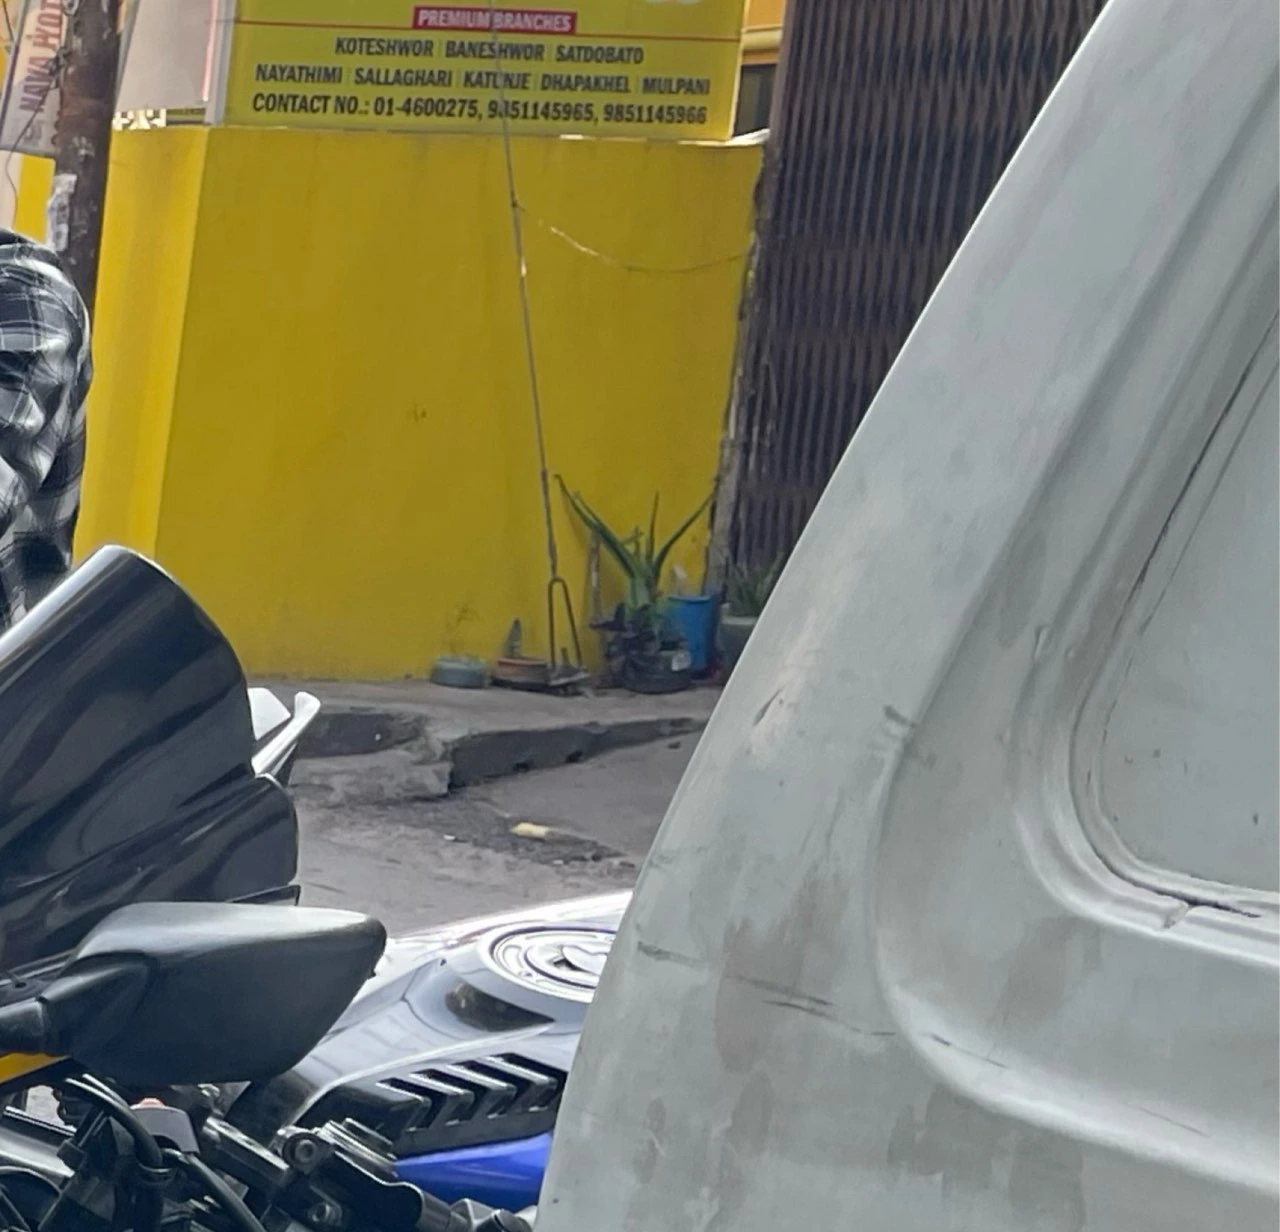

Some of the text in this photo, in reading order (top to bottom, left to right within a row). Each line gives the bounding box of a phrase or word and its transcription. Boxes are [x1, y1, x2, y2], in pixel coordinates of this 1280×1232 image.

[417, 9, 572, 32] PREMIUM BRANCHES
[335, 37, 643, 64] KOTESHWOR BANESHWOR SATDOBATO
[255, 64, 342, 83] NAYATHIMI
[354, 67, 452, 87] SALLAGHARI
[541, 74, 631, 93] DHAPAKHEL
[642, 77, 711, 95] MULPANI
[252, 93, 331, 114] CONTACT
[334, 95, 370, 115] NO.:
[373, 97, 483, 121] 01-4600275,
[603, 103, 707, 124] 9851145966
